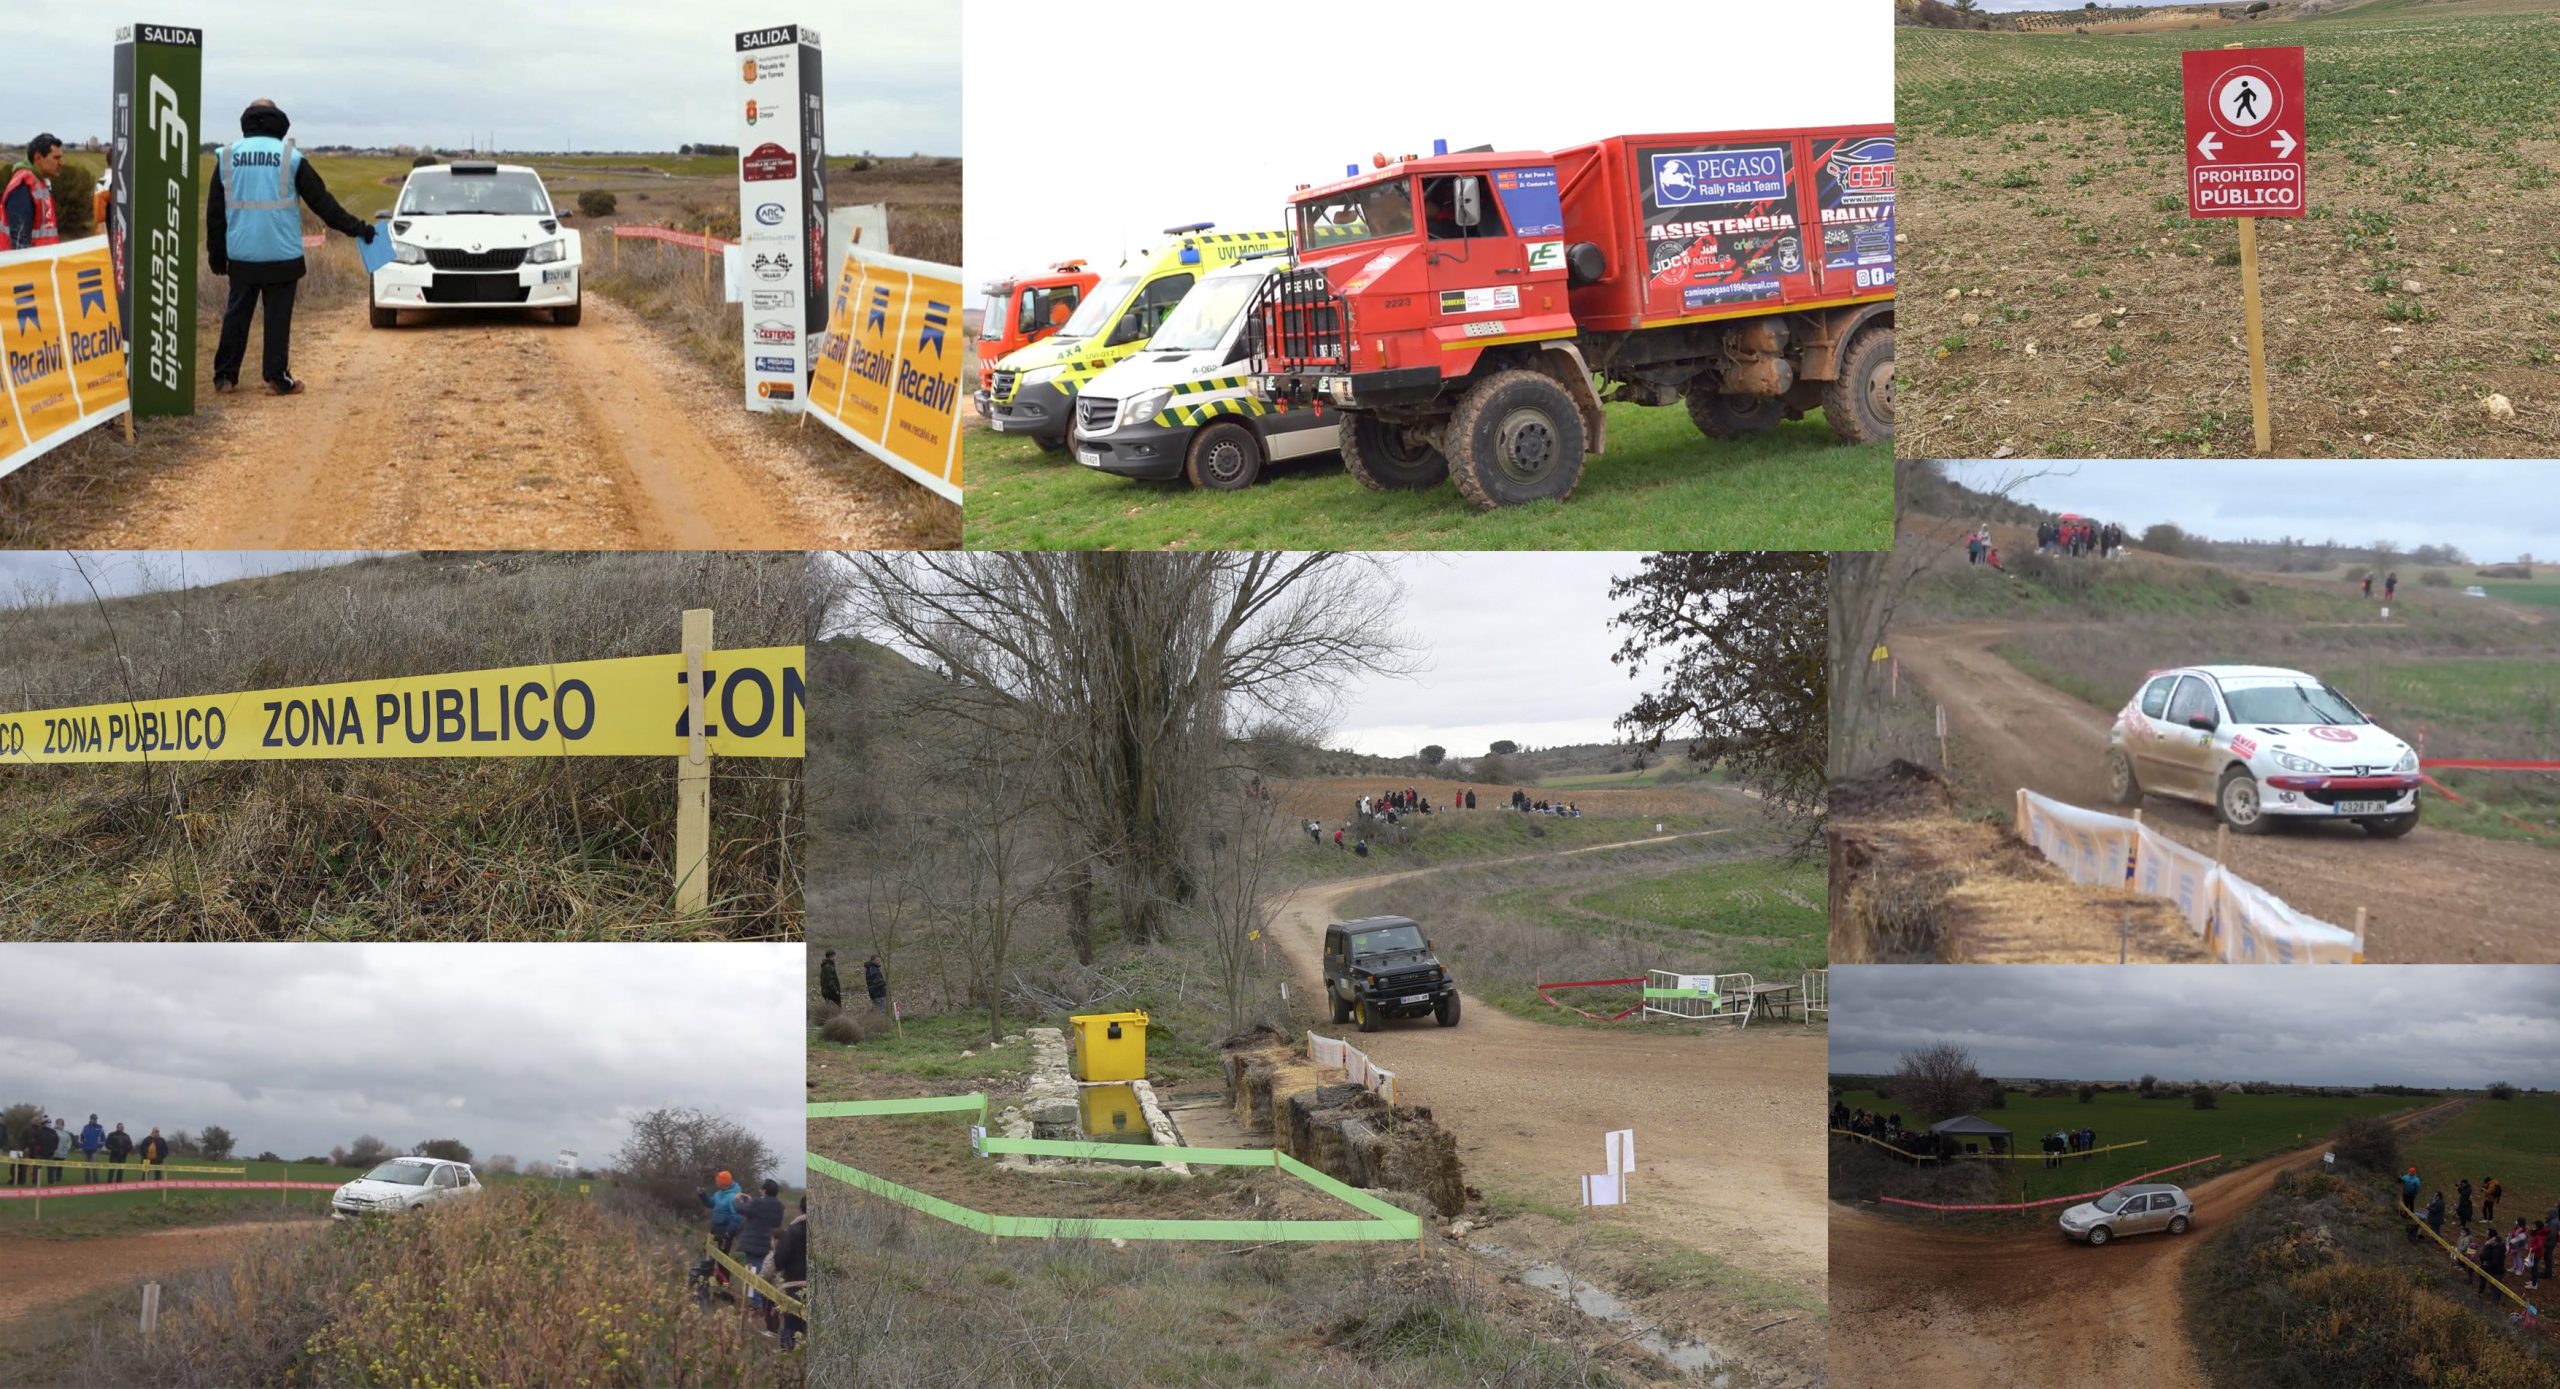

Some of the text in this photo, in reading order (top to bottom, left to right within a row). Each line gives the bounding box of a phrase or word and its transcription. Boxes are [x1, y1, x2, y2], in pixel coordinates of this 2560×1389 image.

[144, 26, 196, 45] SALIDA
[742, 28, 791, 48] SALIDA
[232, 151, 282, 168] SALIDAS
[1697, 155, 1776, 179] PEGASO
[2199, 169, 2295, 183] PROHIBIDO
[1700, 180, 1780, 197] Rally Raid Team
[2200, 184, 2294, 205] PÚBLICO
[1821, 206, 1879, 226] RALLY
[1650, 214, 1796, 241] ASISTENCIA
[165, 178, 182, 391] ESCUDERÍA
[151, 228, 164, 382] CENTRO
[1384, 298, 1411, 308] 2223
[9, 337, 63, 387] Recalvi
[849, 338, 895, 388] Recalvi
[1058, 345, 1082, 360] 4X4
[896, 358, 958, 415] Recalvi
[262, 678, 595, 747] ZONA PUBLICO
[43, 706, 226, 754] ZONA PUBLICO
[2233, 734, 2257, 751] AVIA
